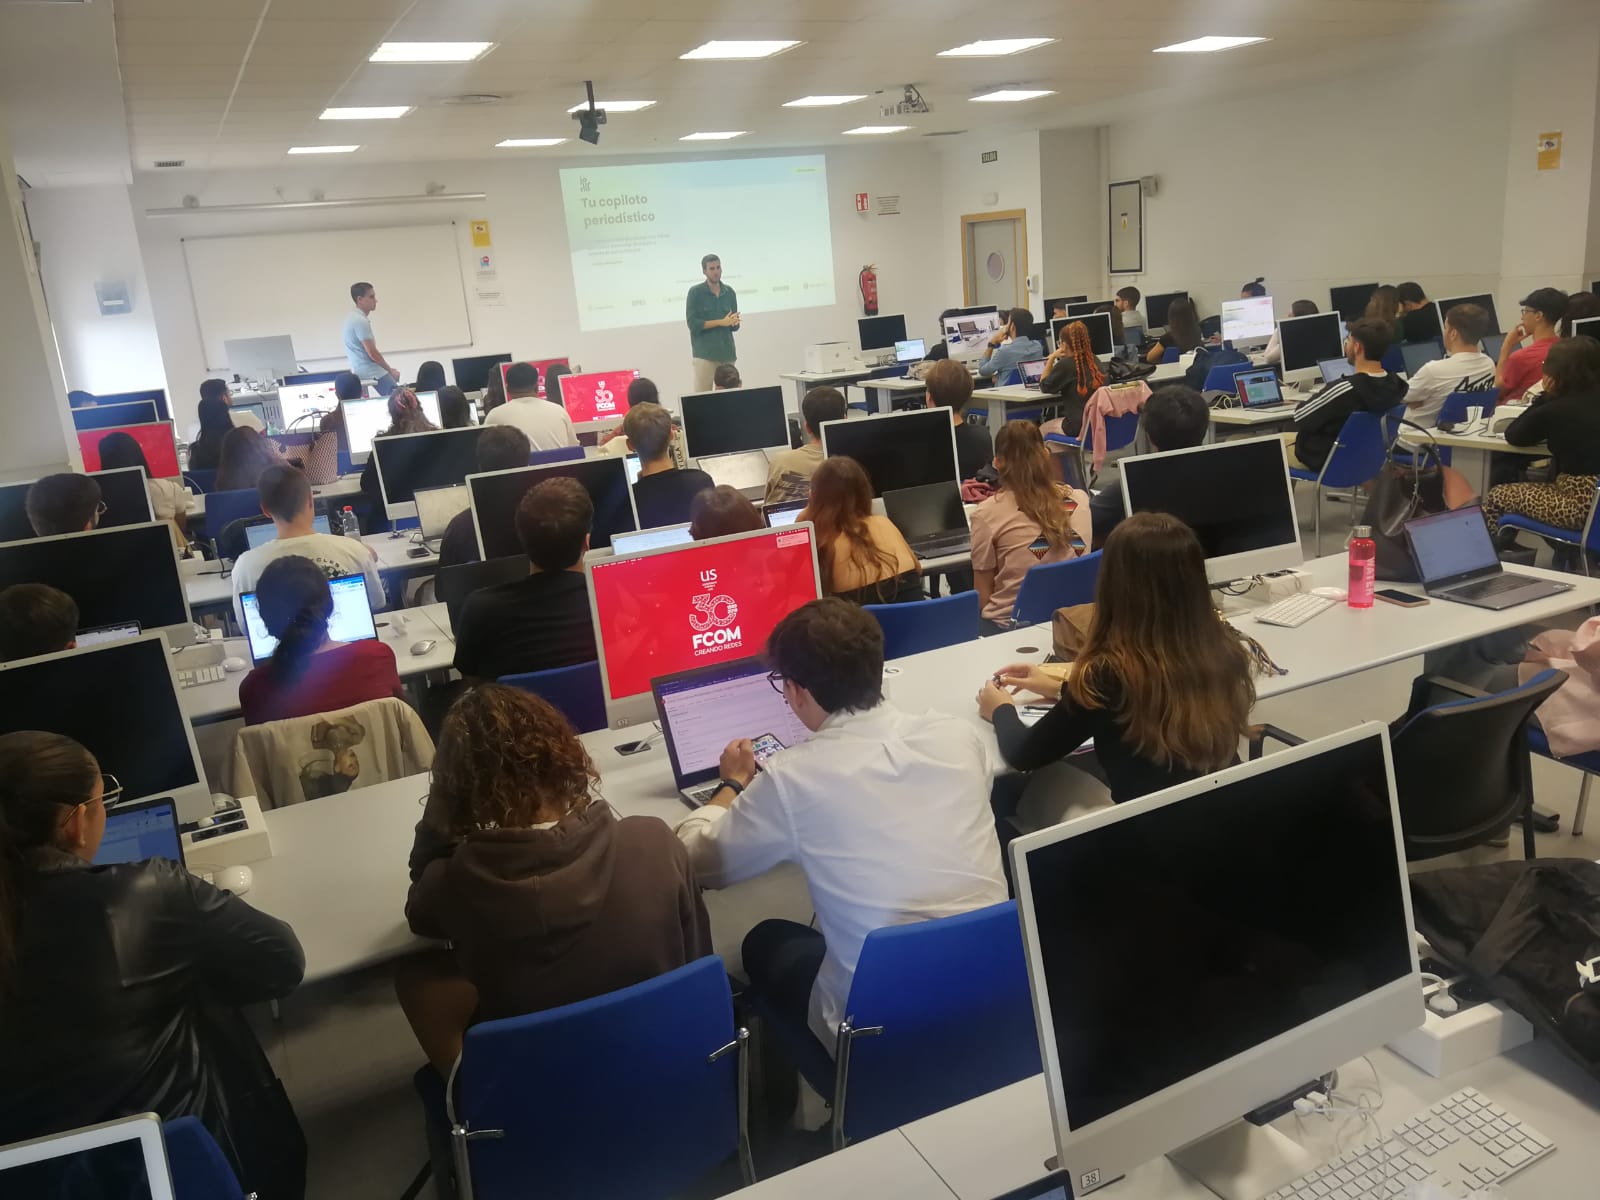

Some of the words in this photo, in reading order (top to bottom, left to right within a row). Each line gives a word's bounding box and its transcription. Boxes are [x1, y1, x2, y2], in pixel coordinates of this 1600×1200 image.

[582, 197, 596, 208] Tu
[599, 194, 648, 210] copiloto
[584, 211, 656, 230] periodístico
[700, 568, 718, 582] US
[1365, 556, 1375, 597] WATER
[689, 593, 738, 631] 30
[692, 625, 742, 649] FCOM
[694, 645, 724, 656] CREANDO
[723, 641, 743, 650] REDES
[1085, 1172, 1097, 1185] 38
